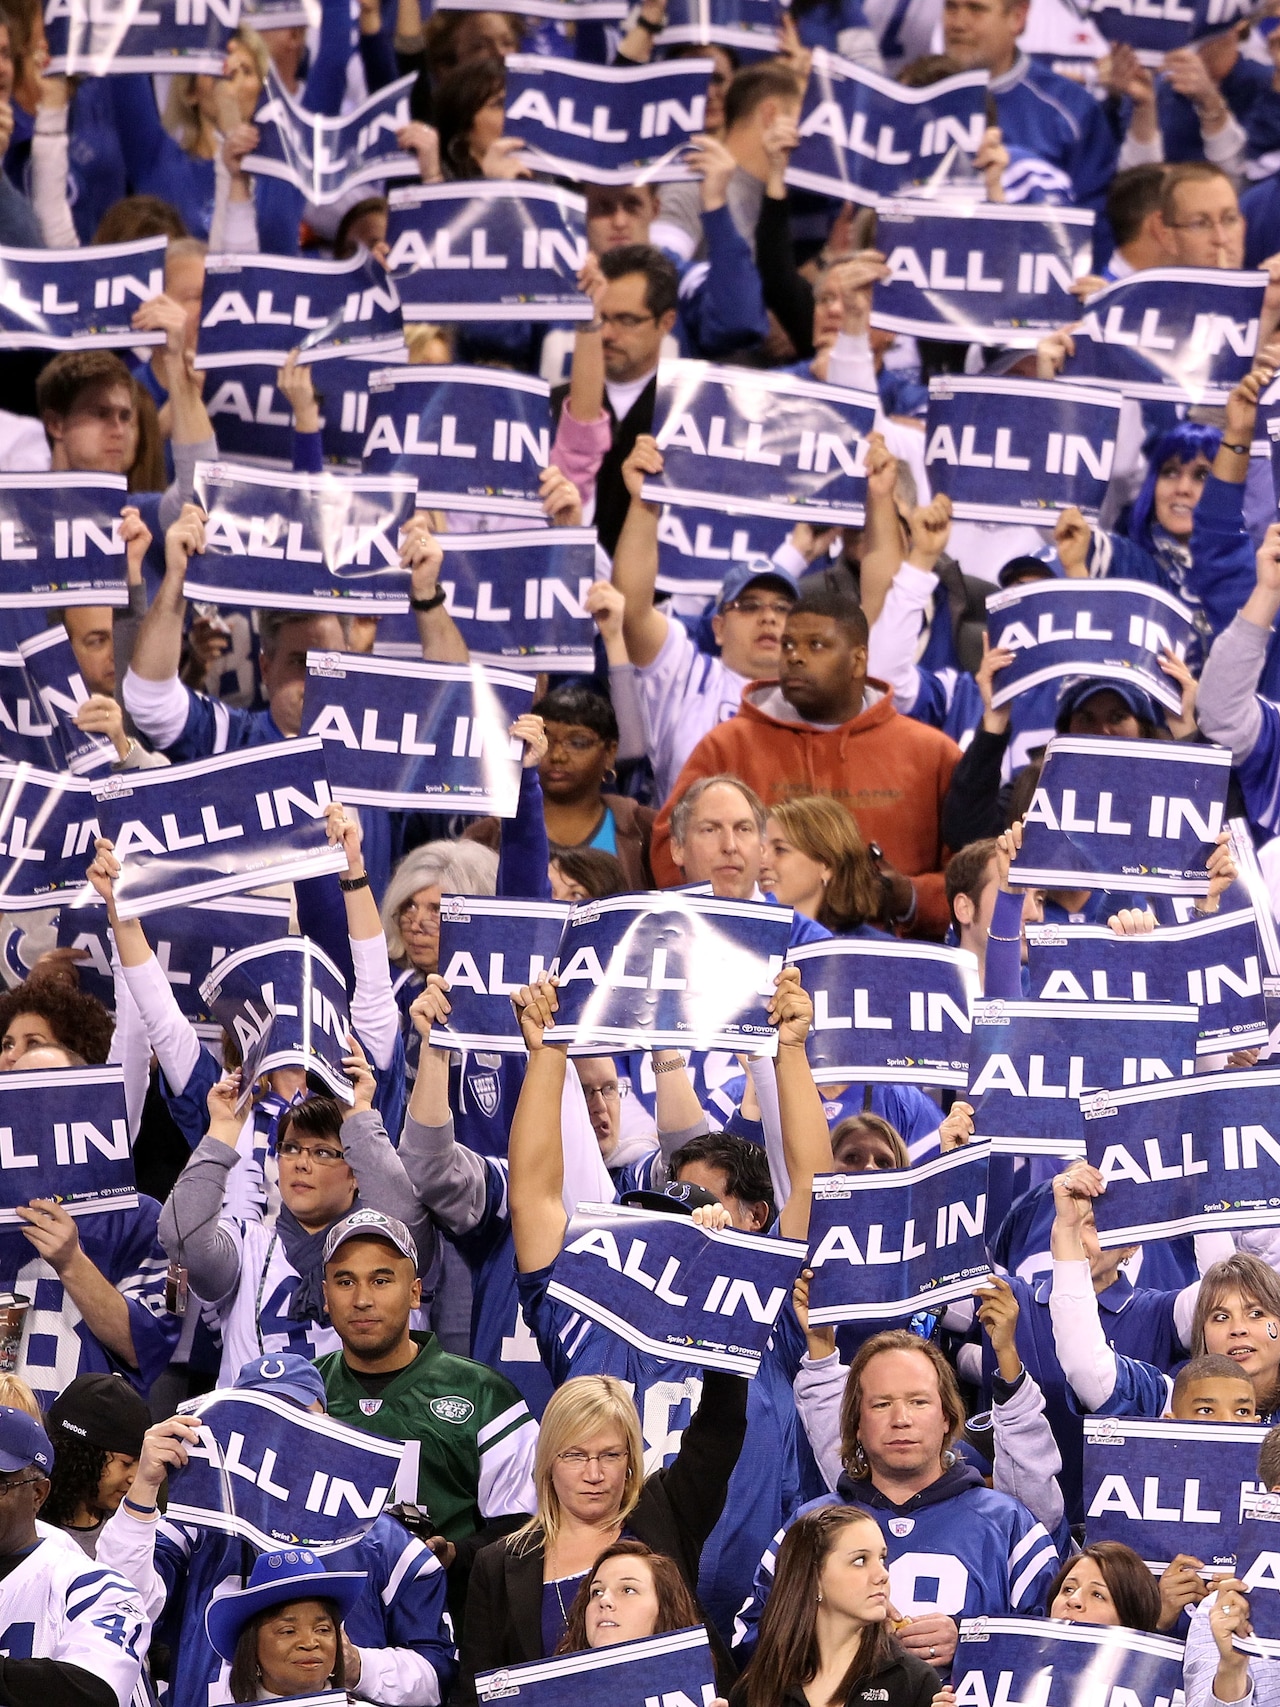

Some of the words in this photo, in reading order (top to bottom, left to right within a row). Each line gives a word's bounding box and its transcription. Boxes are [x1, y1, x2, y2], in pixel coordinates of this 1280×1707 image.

[506, 89, 627, 142] ALL
[639, 95, 707, 139] IN
[799, 101, 911, 166] ALL
[918, 114, 988, 157] IN
[387, 229, 507, 268] ALL
[522, 228, 588, 271] IN
[882, 246, 1002, 294] ALL
[1018, 254, 1083, 293] IN
[95, 268, 162, 308] IN
[202, 291, 327, 327] ALL
[343, 275, 400, 320] IN
[1073, 307, 1177, 351] ALL
[1192, 312, 1259, 358] IN
[363, 414, 476, 458] ALL
[493, 420, 549, 460] IN
[655, 412, 782, 467] ALL
[799, 431, 868, 477] IN
[926, 428, 1030, 471] ALL
[1046, 433, 1114, 481] IN
[55, 520, 124, 558] IN
[206, 515, 325, 565] ALL
[663, 515, 764, 561] ALL
[525, 580, 590, 619] IN
[999, 611, 1112, 651] ALL
[1129, 615, 1187, 660] IN
[309, 709, 449, 755] ALL
[114, 806, 244, 862] ALL
[256, 780, 331, 830] IN
[1028, 790, 1131, 835] ALL
[1149, 796, 1222, 837] IN
[1121, 866, 1139, 875] Sprint
[557, 946, 688, 990] ALL
[1040, 970, 1170, 1002] ALL
[1188, 956, 1261, 1006] IN
[910, 992, 972, 1031] IN
[976, 1017, 1010, 1025] PLAYOFFS
[1241, 1021, 1265, 1030] TOYOTA
[969, 1054, 1097, 1098] ALL
[1085, 1109, 1117, 1118] PLAYOFFS
[54, 1119, 129, 1165] IN
[1099, 1133, 1207, 1181] ALL
[810, 1219, 926, 1267] ALL
[936, 1194, 986, 1248] IN
[1204, 1203, 1222, 1212] Sprint
[567, 1228, 688, 1306] ALL
[703, 1276, 786, 1324] IN
[667, 1335, 685, 1345] Sprint
[738, 1346, 761, 1357] TOYOTA
[61, 1419, 87, 1437] Reebok
[1088, 1437, 1124, 1445] PLAYOFFS
[186, 1427, 289, 1501] ALL
[305, 1471, 388, 1518] IN
[1087, 1475, 1220, 1523] ALL
[91, 1613, 142, 1663] 41
[953, 1665, 1053, 1707] ALL
